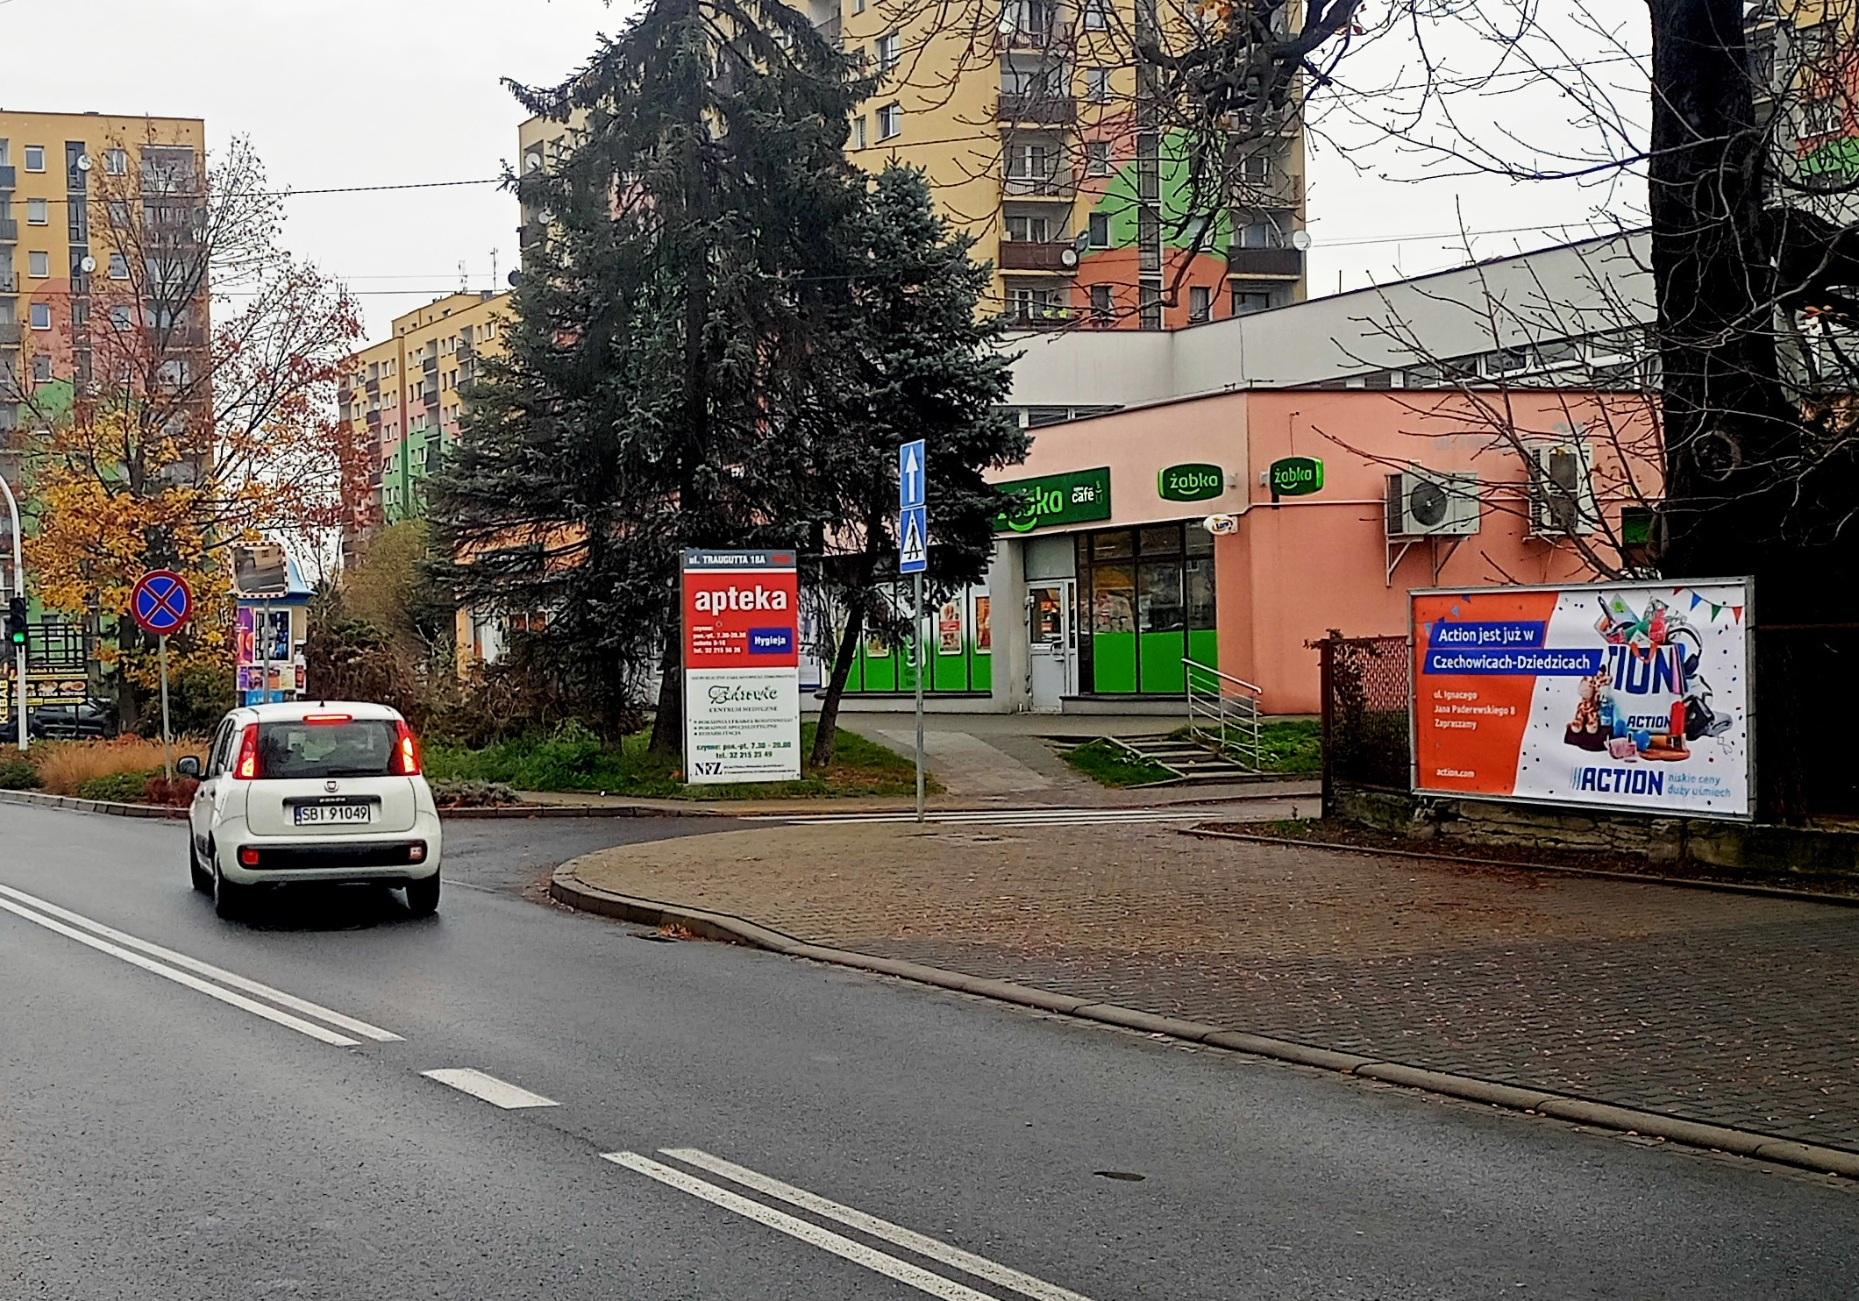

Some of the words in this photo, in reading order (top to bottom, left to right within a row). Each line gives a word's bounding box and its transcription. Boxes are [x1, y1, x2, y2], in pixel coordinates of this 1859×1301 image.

[1169, 473, 1219, 489] żabka
[1274, 467, 1312, 483] żabka
[1071, 487, 1094, 503] café
[702, 555, 749, 564] TRAUGUTTA
[750, 555, 766, 564] 18A
[694, 585, 788, 617] apteka
[754, 636, 786, 647] Hygieja
[1438, 627, 1476, 642] Action
[1477, 627, 1500, 644] jest
[1502, 626, 1522, 644] już
[1523, 630, 1534, 641] w
[1433, 654, 1591, 669] Czechowicach-Dziedzicach
[1434, 704, 1451, 714] Jana
[1451, 705, 1509, 716] Paderewskiego
[1434, 719, 1477, 730] Zapraszamy
[1627, 715, 1672, 729] ACTION
[1436, 768, 1475, 778] action.com
[1668, 773, 1697, 783] niskie
[1698, 775, 1721, 786] ceny
[1581, 767, 1664, 796] ACTION
[1667, 785, 1690, 797] duży
[1691, 786, 1731, 798] uśmiech
[302, 807, 324, 821] SBI
[329, 806, 367, 820] 91049
